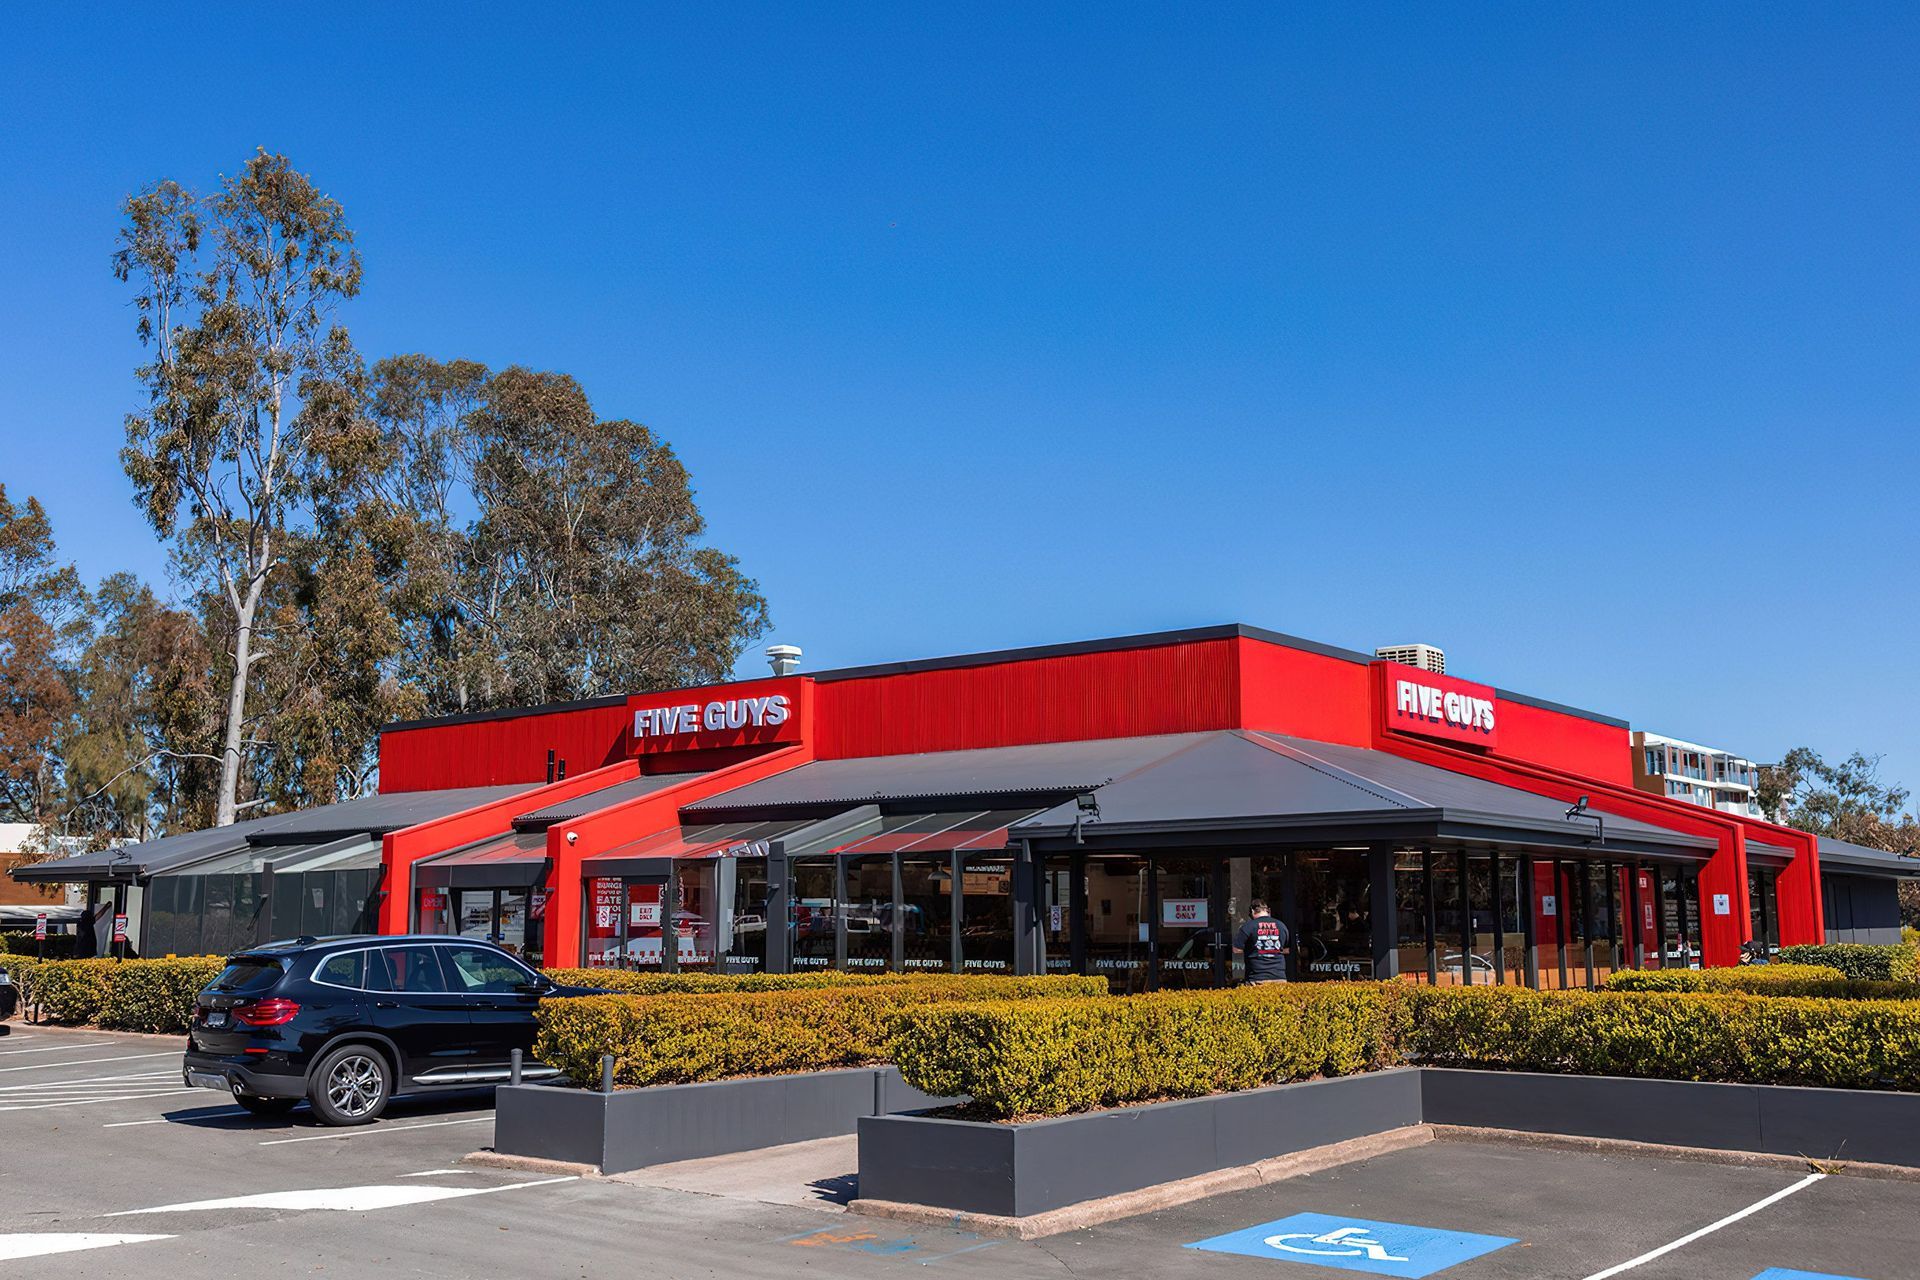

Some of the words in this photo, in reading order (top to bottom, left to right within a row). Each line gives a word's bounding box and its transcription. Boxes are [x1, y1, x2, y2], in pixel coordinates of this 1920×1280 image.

[1397, 680, 1443, 718] FIVE
[1444, 692, 1495, 730] GUYS
[634, 705, 699, 737] FIVE
[704, 695, 790, 731] GUYS
[1175, 904, 1196, 912] EXIT
[1175, 912, 1197, 920] ONLY
[726, 956, 741, 964] FIVE
[741, 956, 759, 964] GUYS
[793, 957, 808, 965] FIVE
[809, 957, 829, 965] GUYS
[847, 958, 864, 966] FIVE
[864, 958, 885, 966] GUYS
[904, 959, 922, 967] FIVE
[922, 959, 944, 967] GUYS
[964, 960, 982, 968] FIVE
[983, 960, 1006, 968] GUYS
[1096, 960, 1115, 968] FIVE
[1116, 960, 1139, 968] GUYS
[1164, 961, 1184, 970] FIVE
[1185, 961, 1210, 970] GUYS
[1232, 962, 1246, 971] FIV
[1310, 963, 1332, 972] FIVE
[1333, 963, 1361, 972] GUYS
